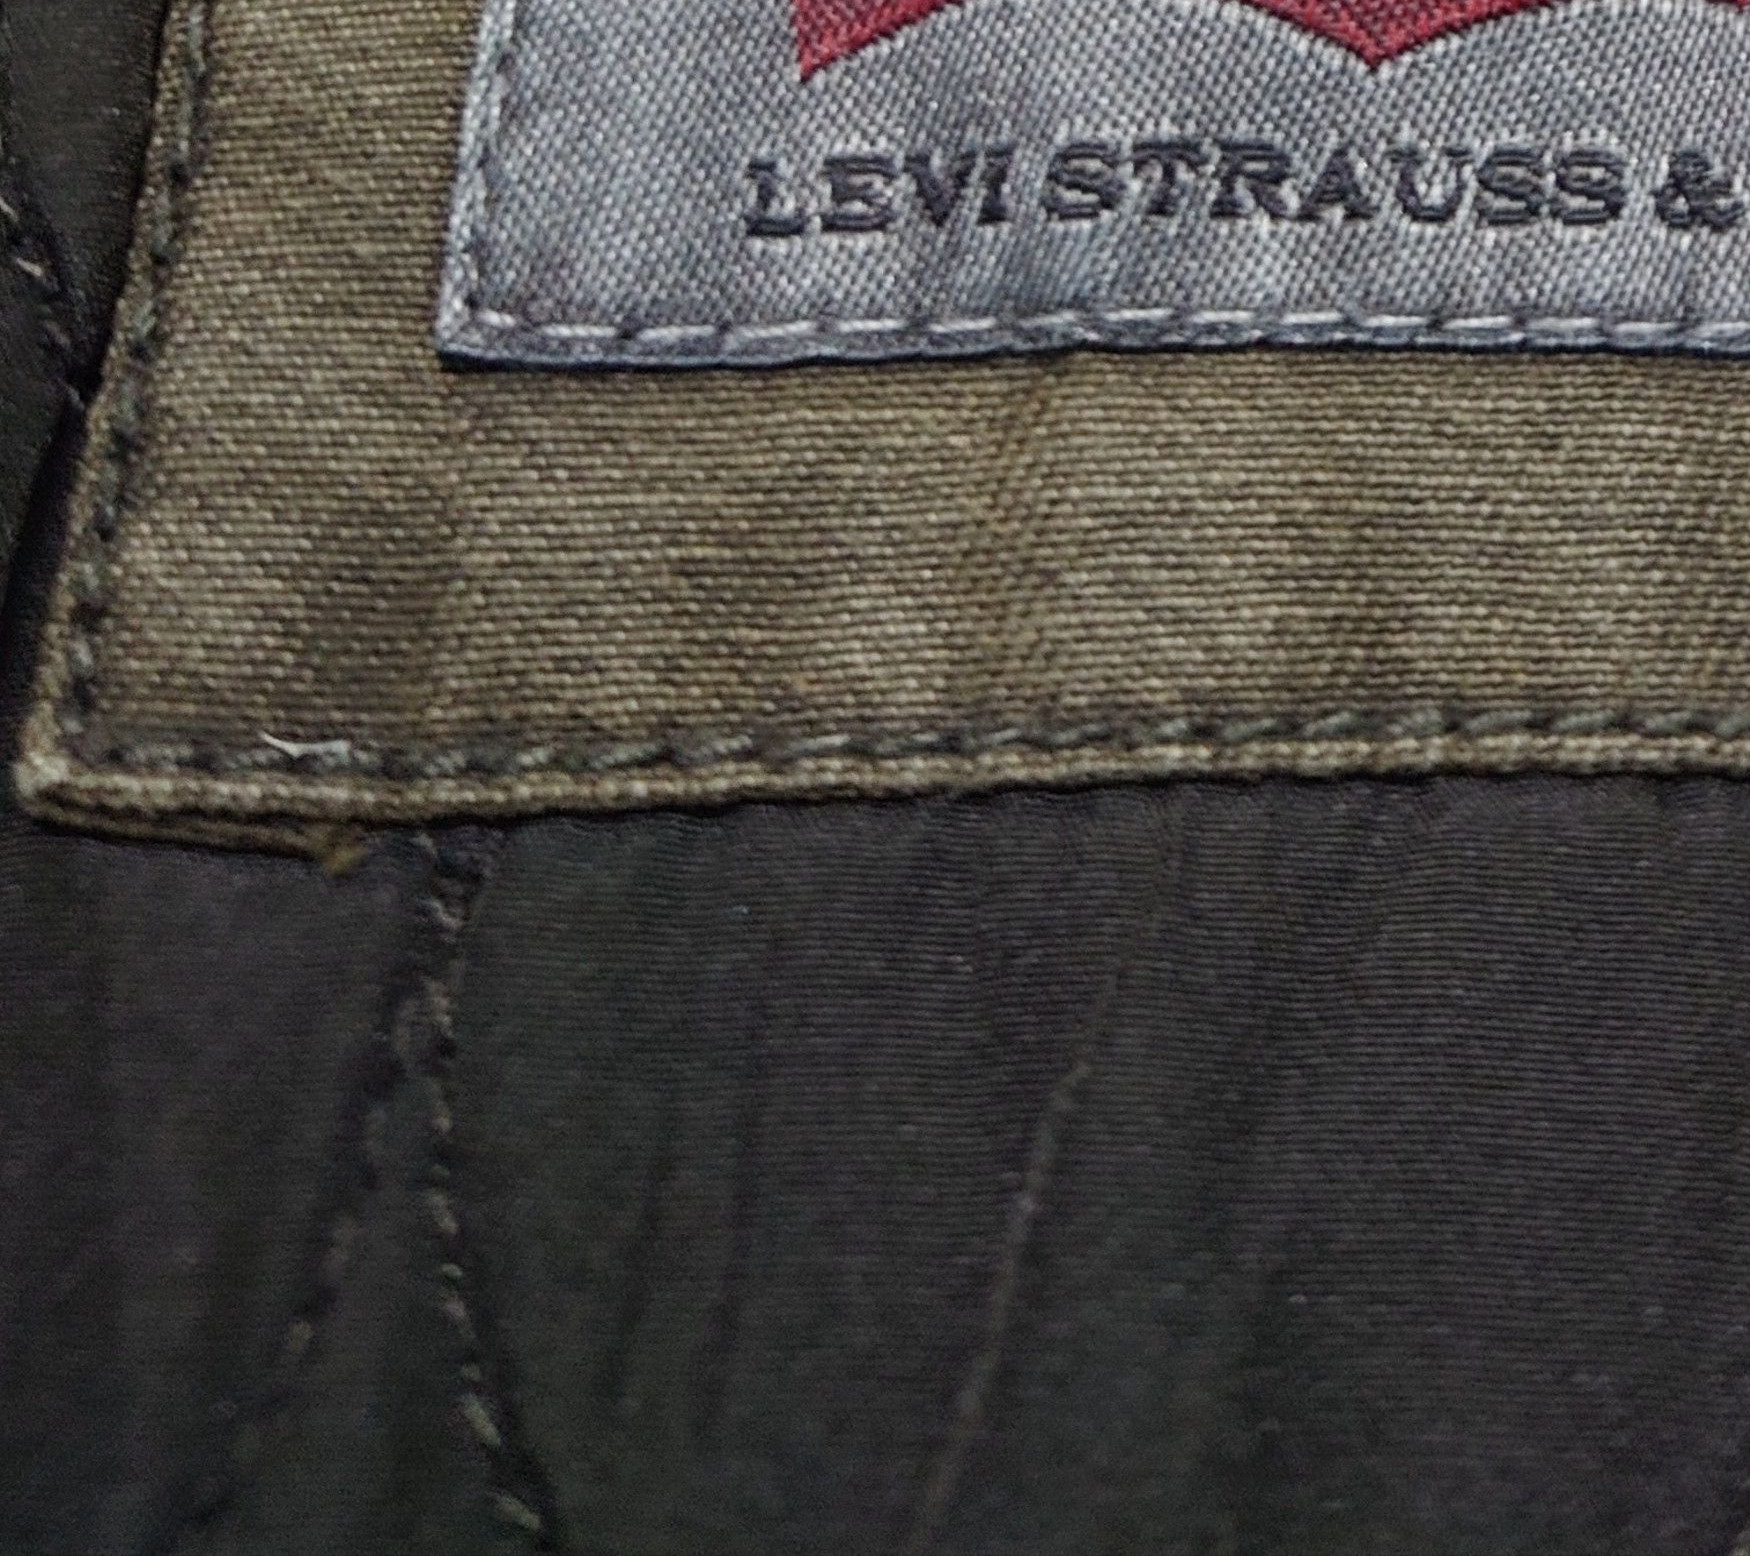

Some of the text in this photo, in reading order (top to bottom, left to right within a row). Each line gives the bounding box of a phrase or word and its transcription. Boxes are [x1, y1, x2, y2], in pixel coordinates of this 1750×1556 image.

[745, 141, 1012, 237] LEVI
[1048, 141, 1624, 225] STRAUSS
[1655, 149, 1742, 233] &
